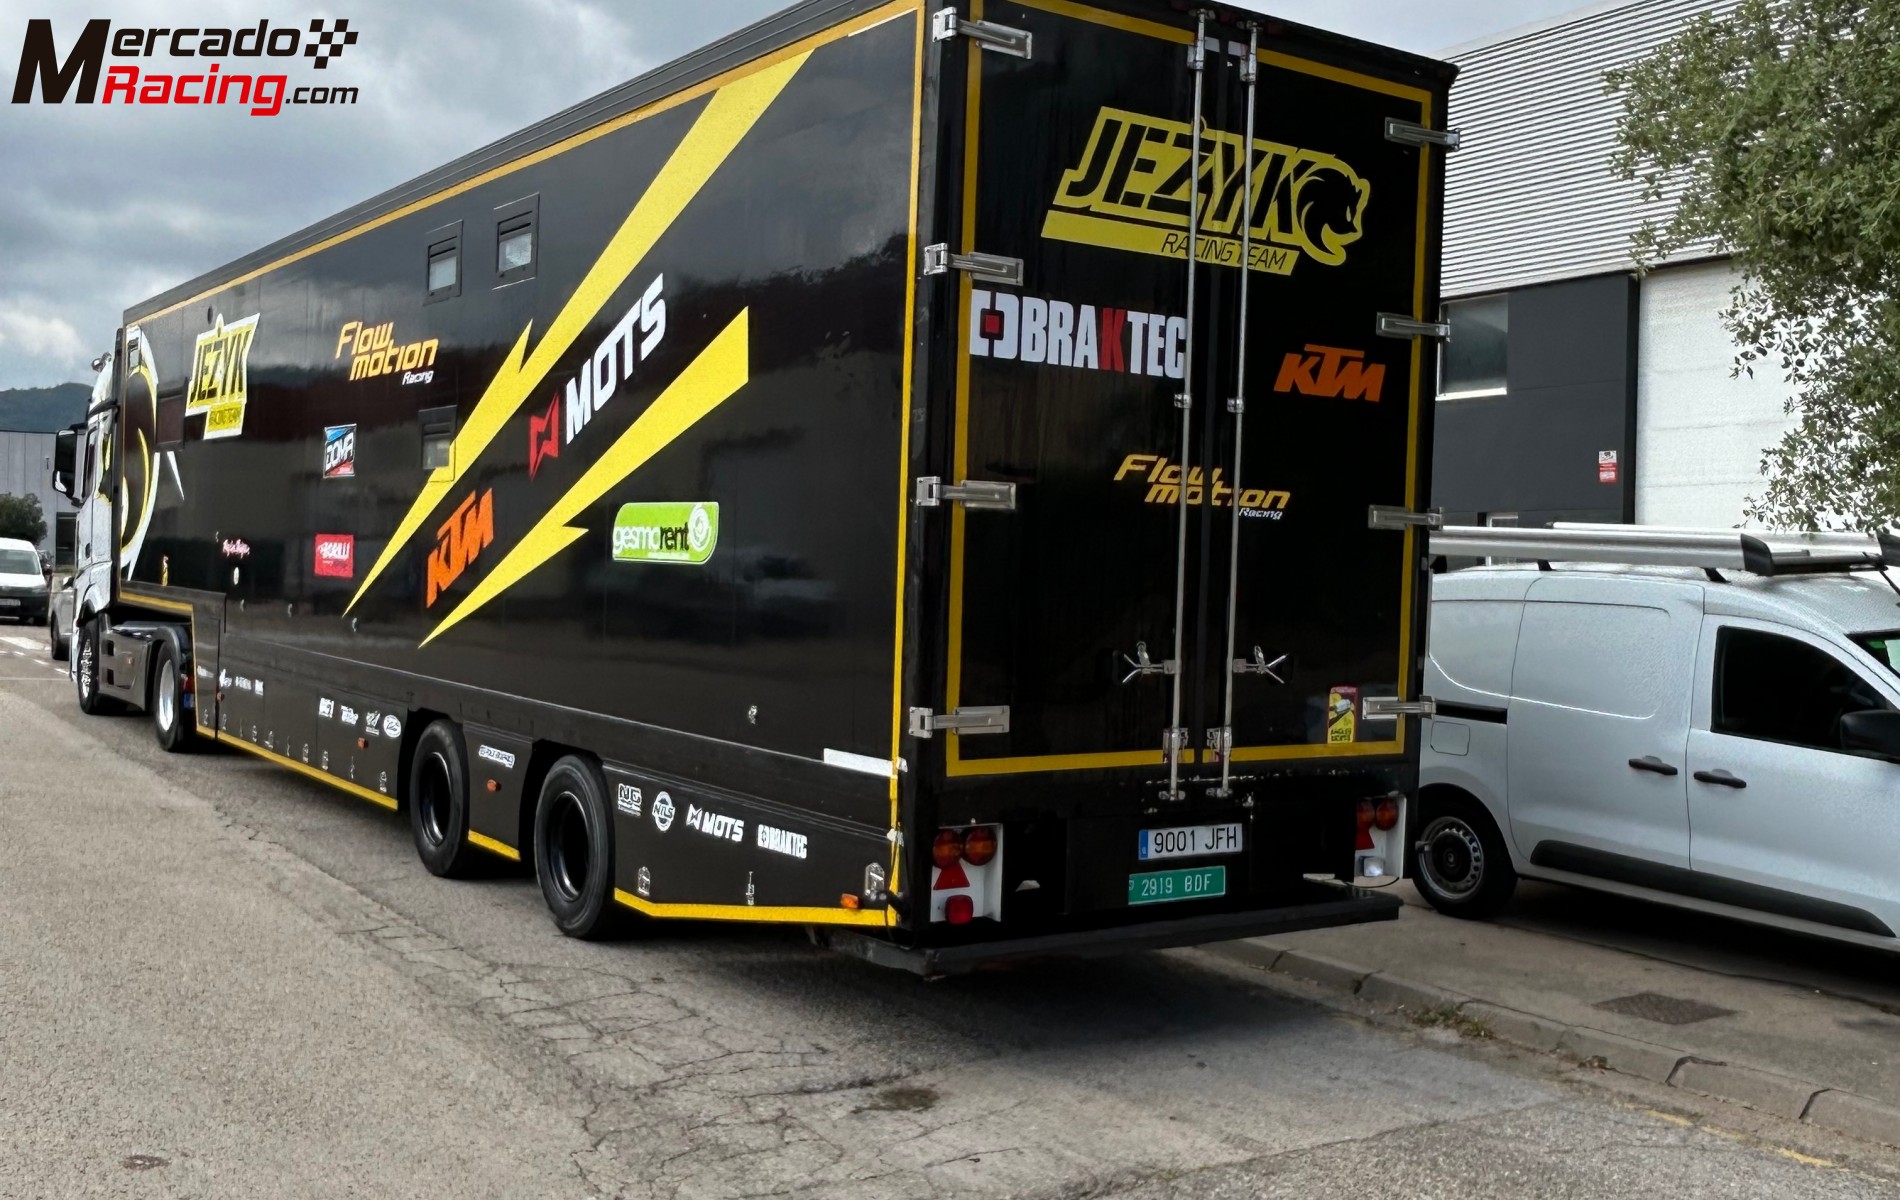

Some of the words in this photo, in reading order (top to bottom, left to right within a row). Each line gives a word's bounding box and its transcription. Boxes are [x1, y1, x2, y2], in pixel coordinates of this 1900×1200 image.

[335, 320, 395, 360] Flow
[348, 338, 439, 381] motion
[566, 272, 667, 445] MOTS
[402, 370, 434, 386] Racing
[1273, 342, 1387, 402] KTM
[426, 487, 494, 609] KTM
[701, 810, 745, 842] MOTS
[1154, 829, 1196, 854] 9001
[1204, 826, 1237, 850] JFH
[1141, 876, 1173, 897] 2919
[1184, 873, 1212, 892] BDF
